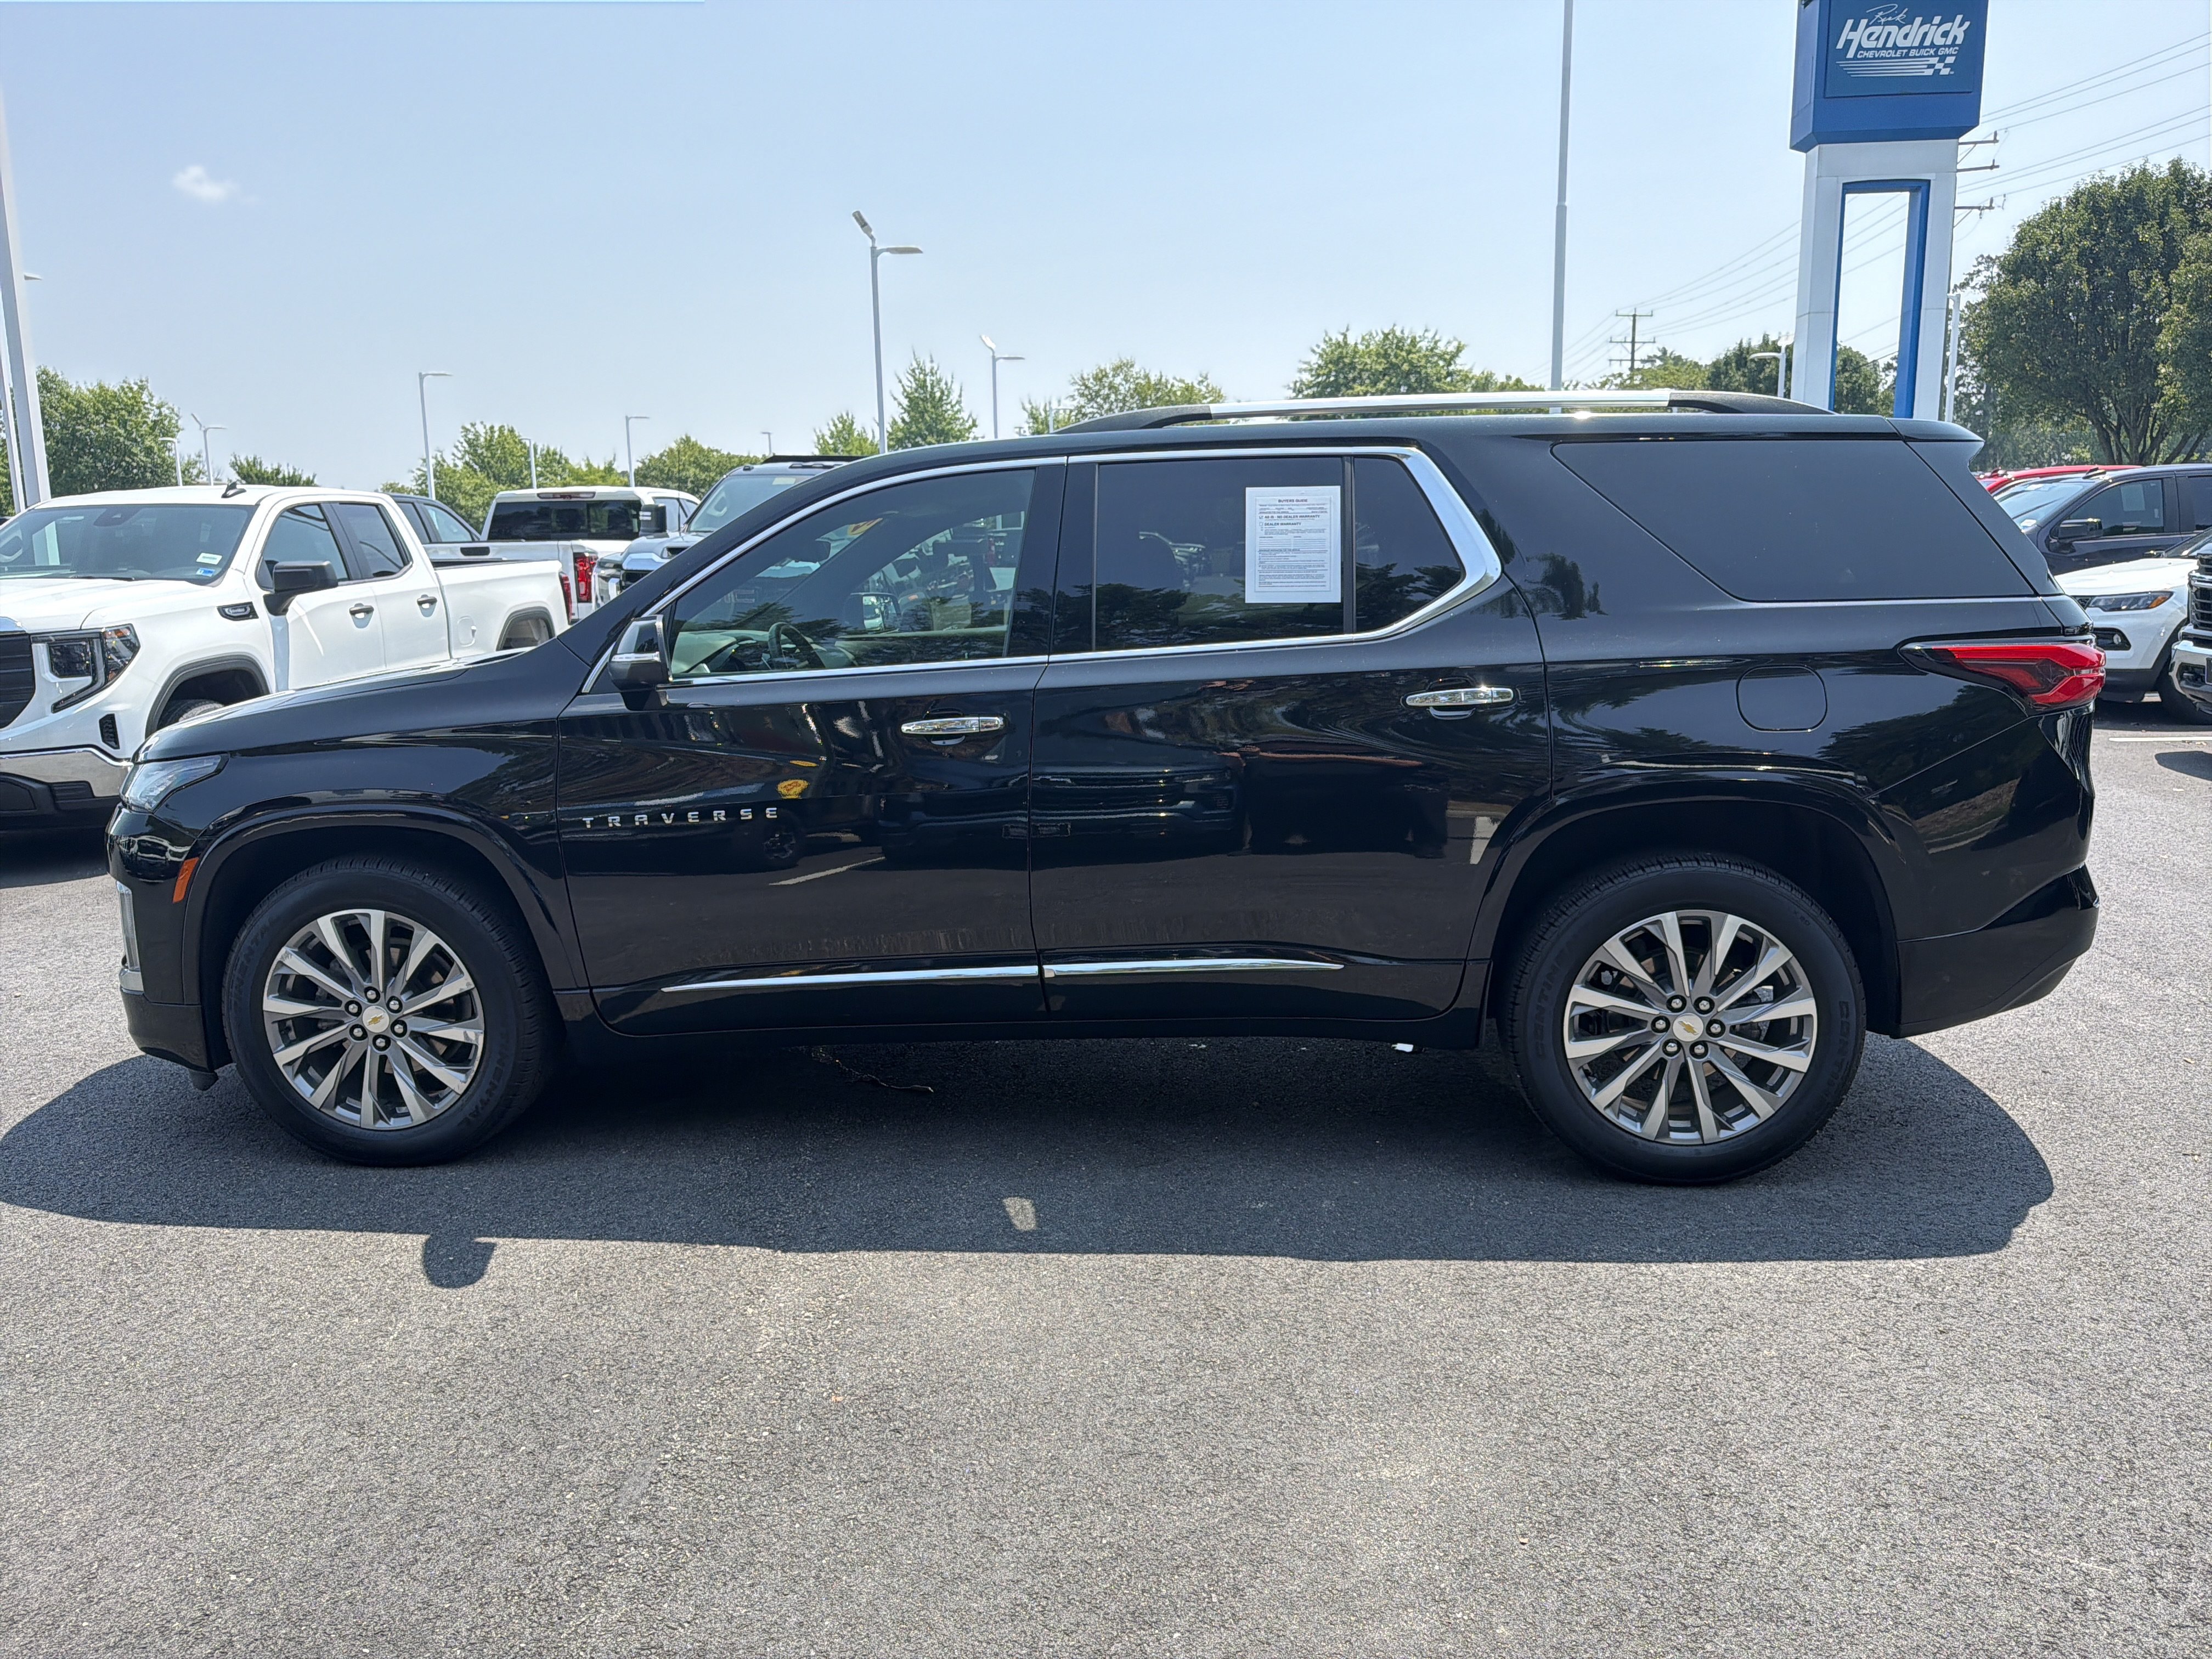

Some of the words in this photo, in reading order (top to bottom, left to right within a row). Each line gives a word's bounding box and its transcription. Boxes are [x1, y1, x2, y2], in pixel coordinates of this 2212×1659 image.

[1866, 3, 1909, 25] Rick
[1836, 14, 1971, 59] Hendrick
[1857, 49, 1908, 58] CHEVROLET
[1909, 48, 1937, 57] BUICK
[1938, 47, 1959, 55] GMC
[582, 807, 778, 829] TRAVERSE
